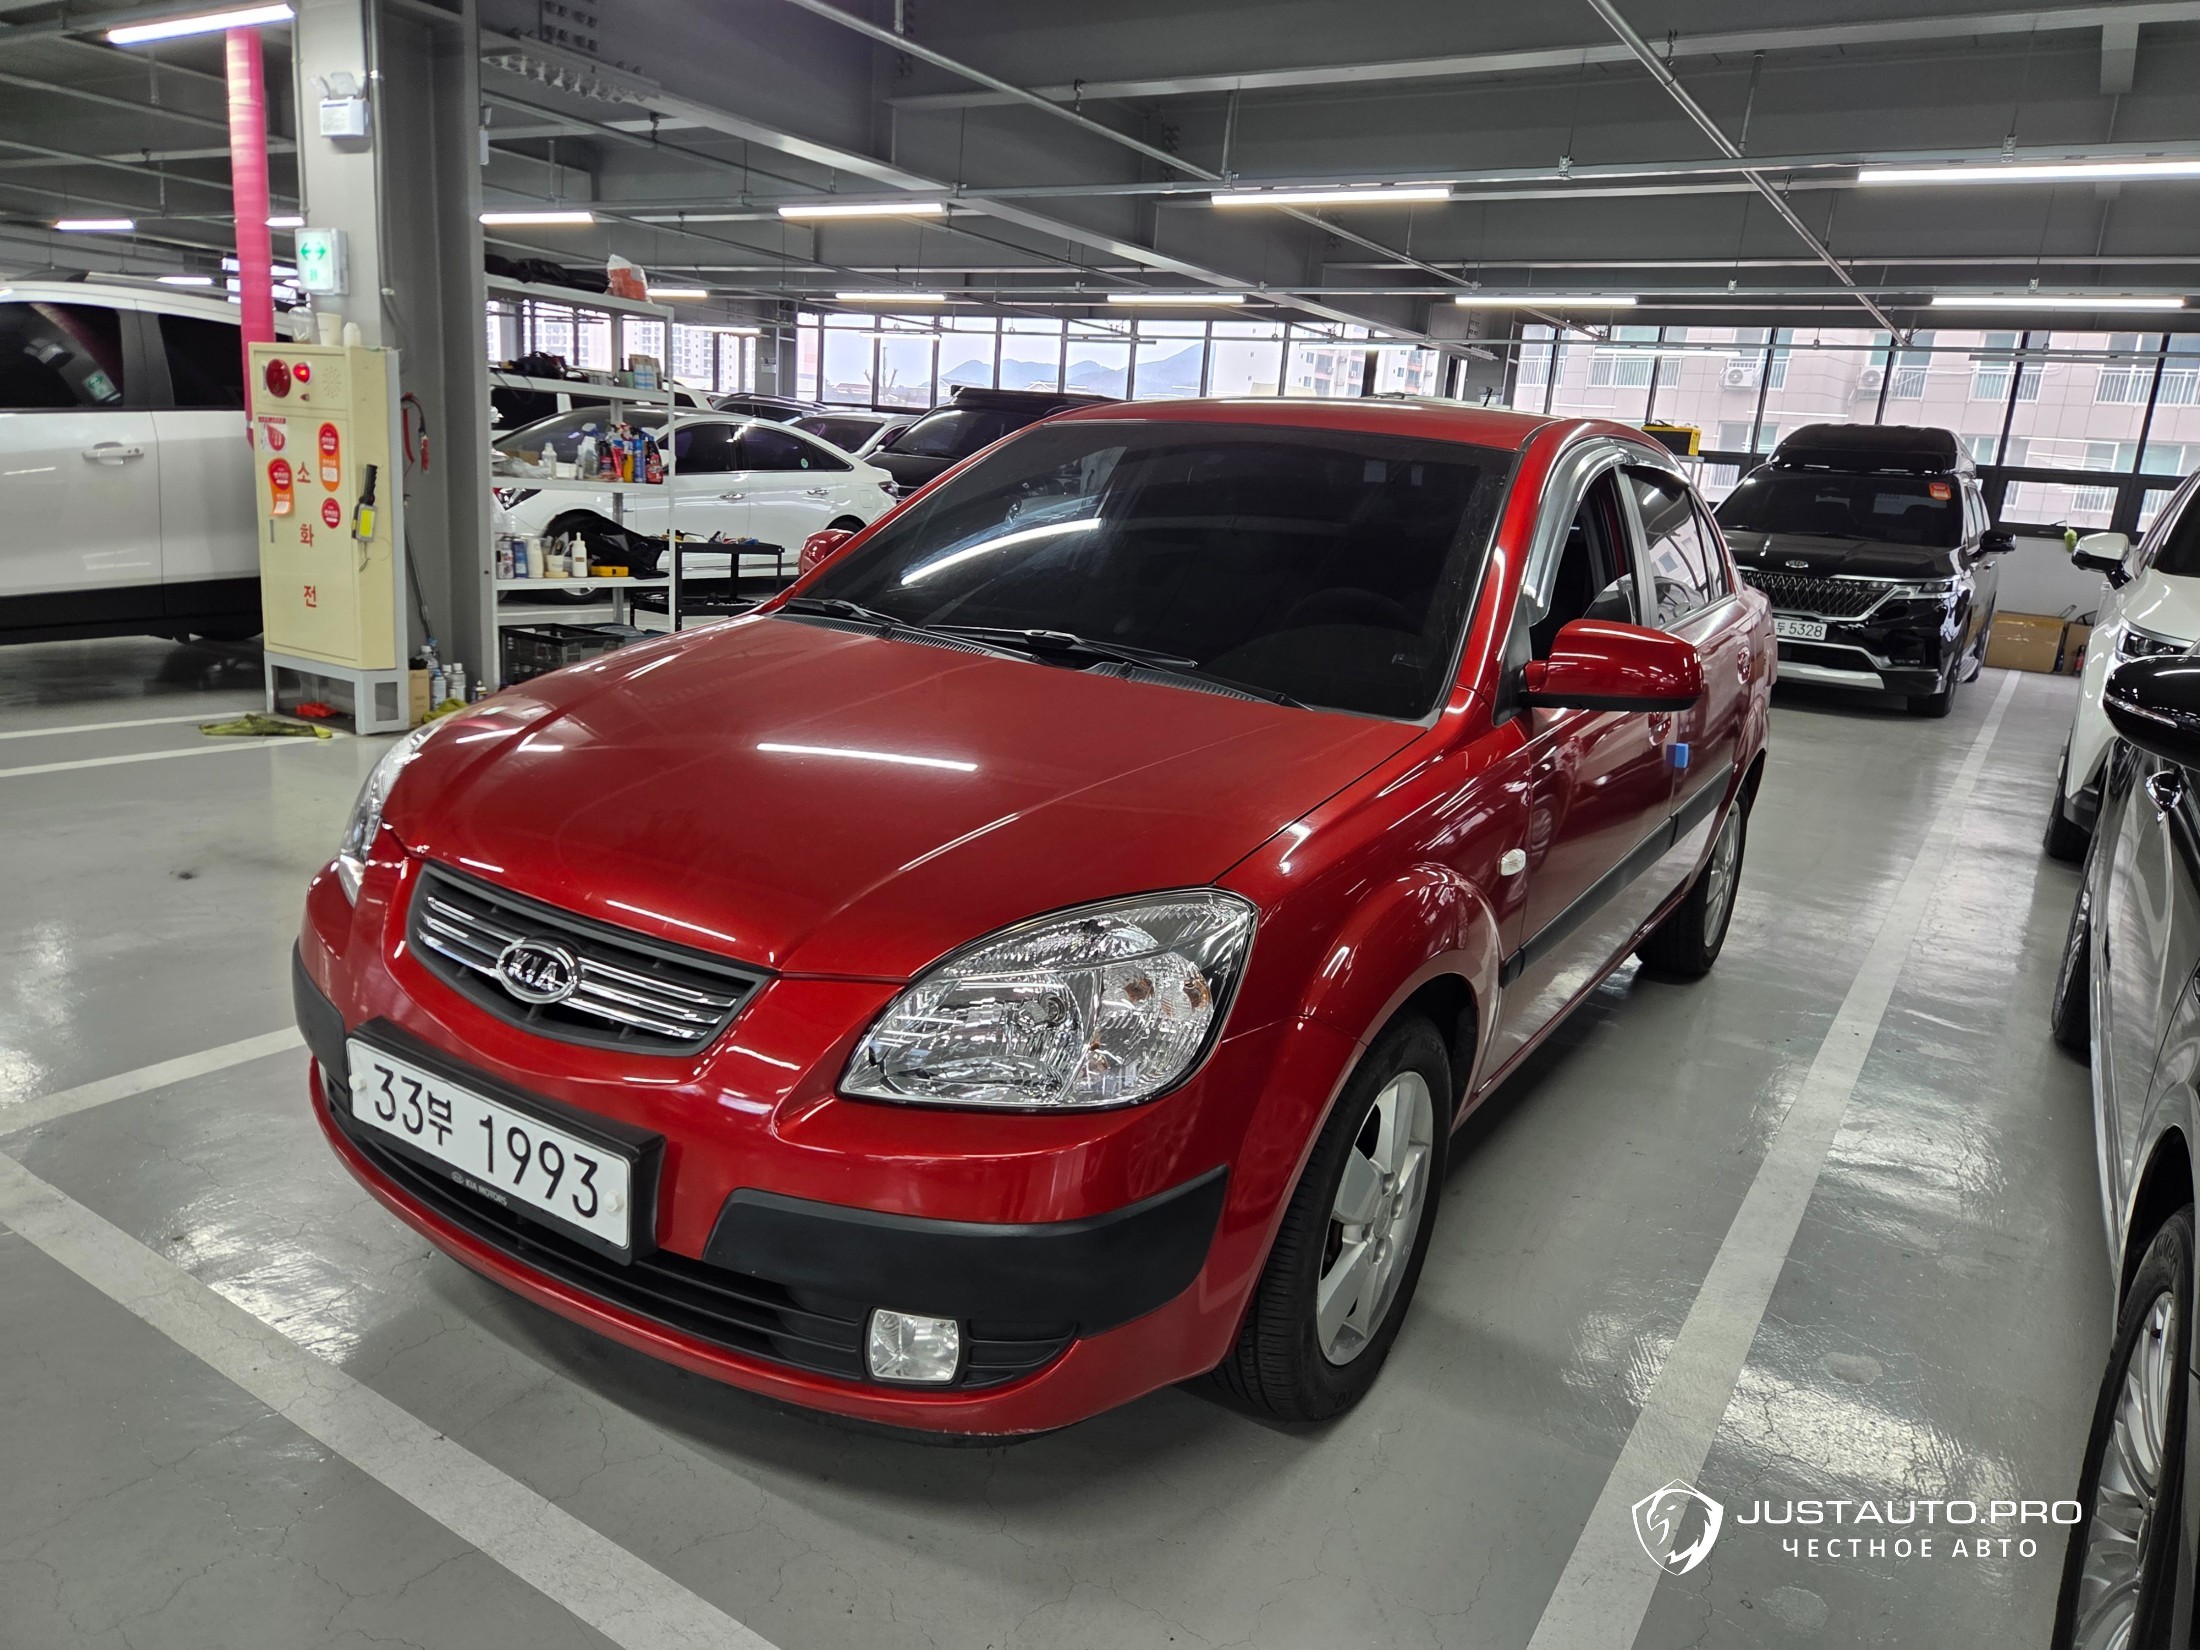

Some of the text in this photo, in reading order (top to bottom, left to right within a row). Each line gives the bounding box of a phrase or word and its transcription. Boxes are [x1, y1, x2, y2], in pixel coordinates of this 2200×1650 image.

[1788, 623, 1824, 638] 5328
[507, 948, 558, 991] KIA
[374, 1063, 599, 1219] 33부 1993
[465, 1178, 508, 1207] KIA MOTORS
